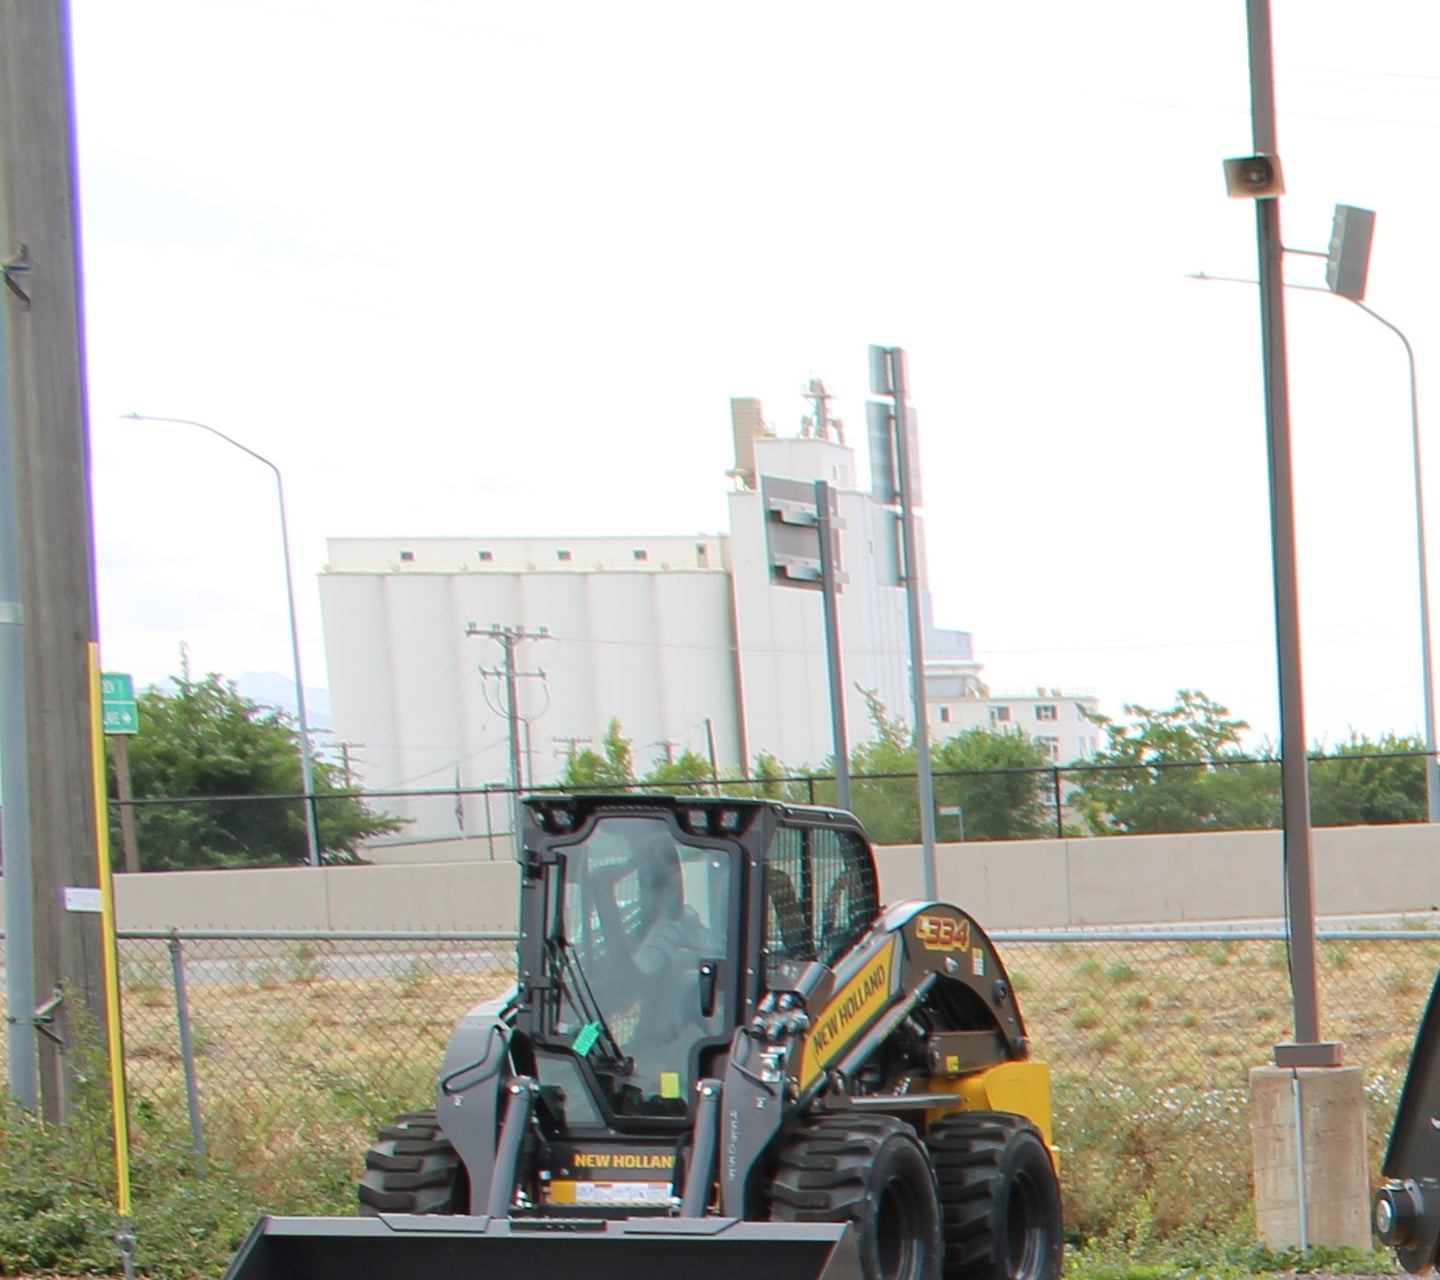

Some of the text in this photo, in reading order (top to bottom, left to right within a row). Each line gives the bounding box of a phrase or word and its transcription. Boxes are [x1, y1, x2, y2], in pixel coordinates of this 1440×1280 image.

[813, 964, 886, 1055] NEW HOLLAND
[574, 1154, 676, 1169] NEW HOLLAN
